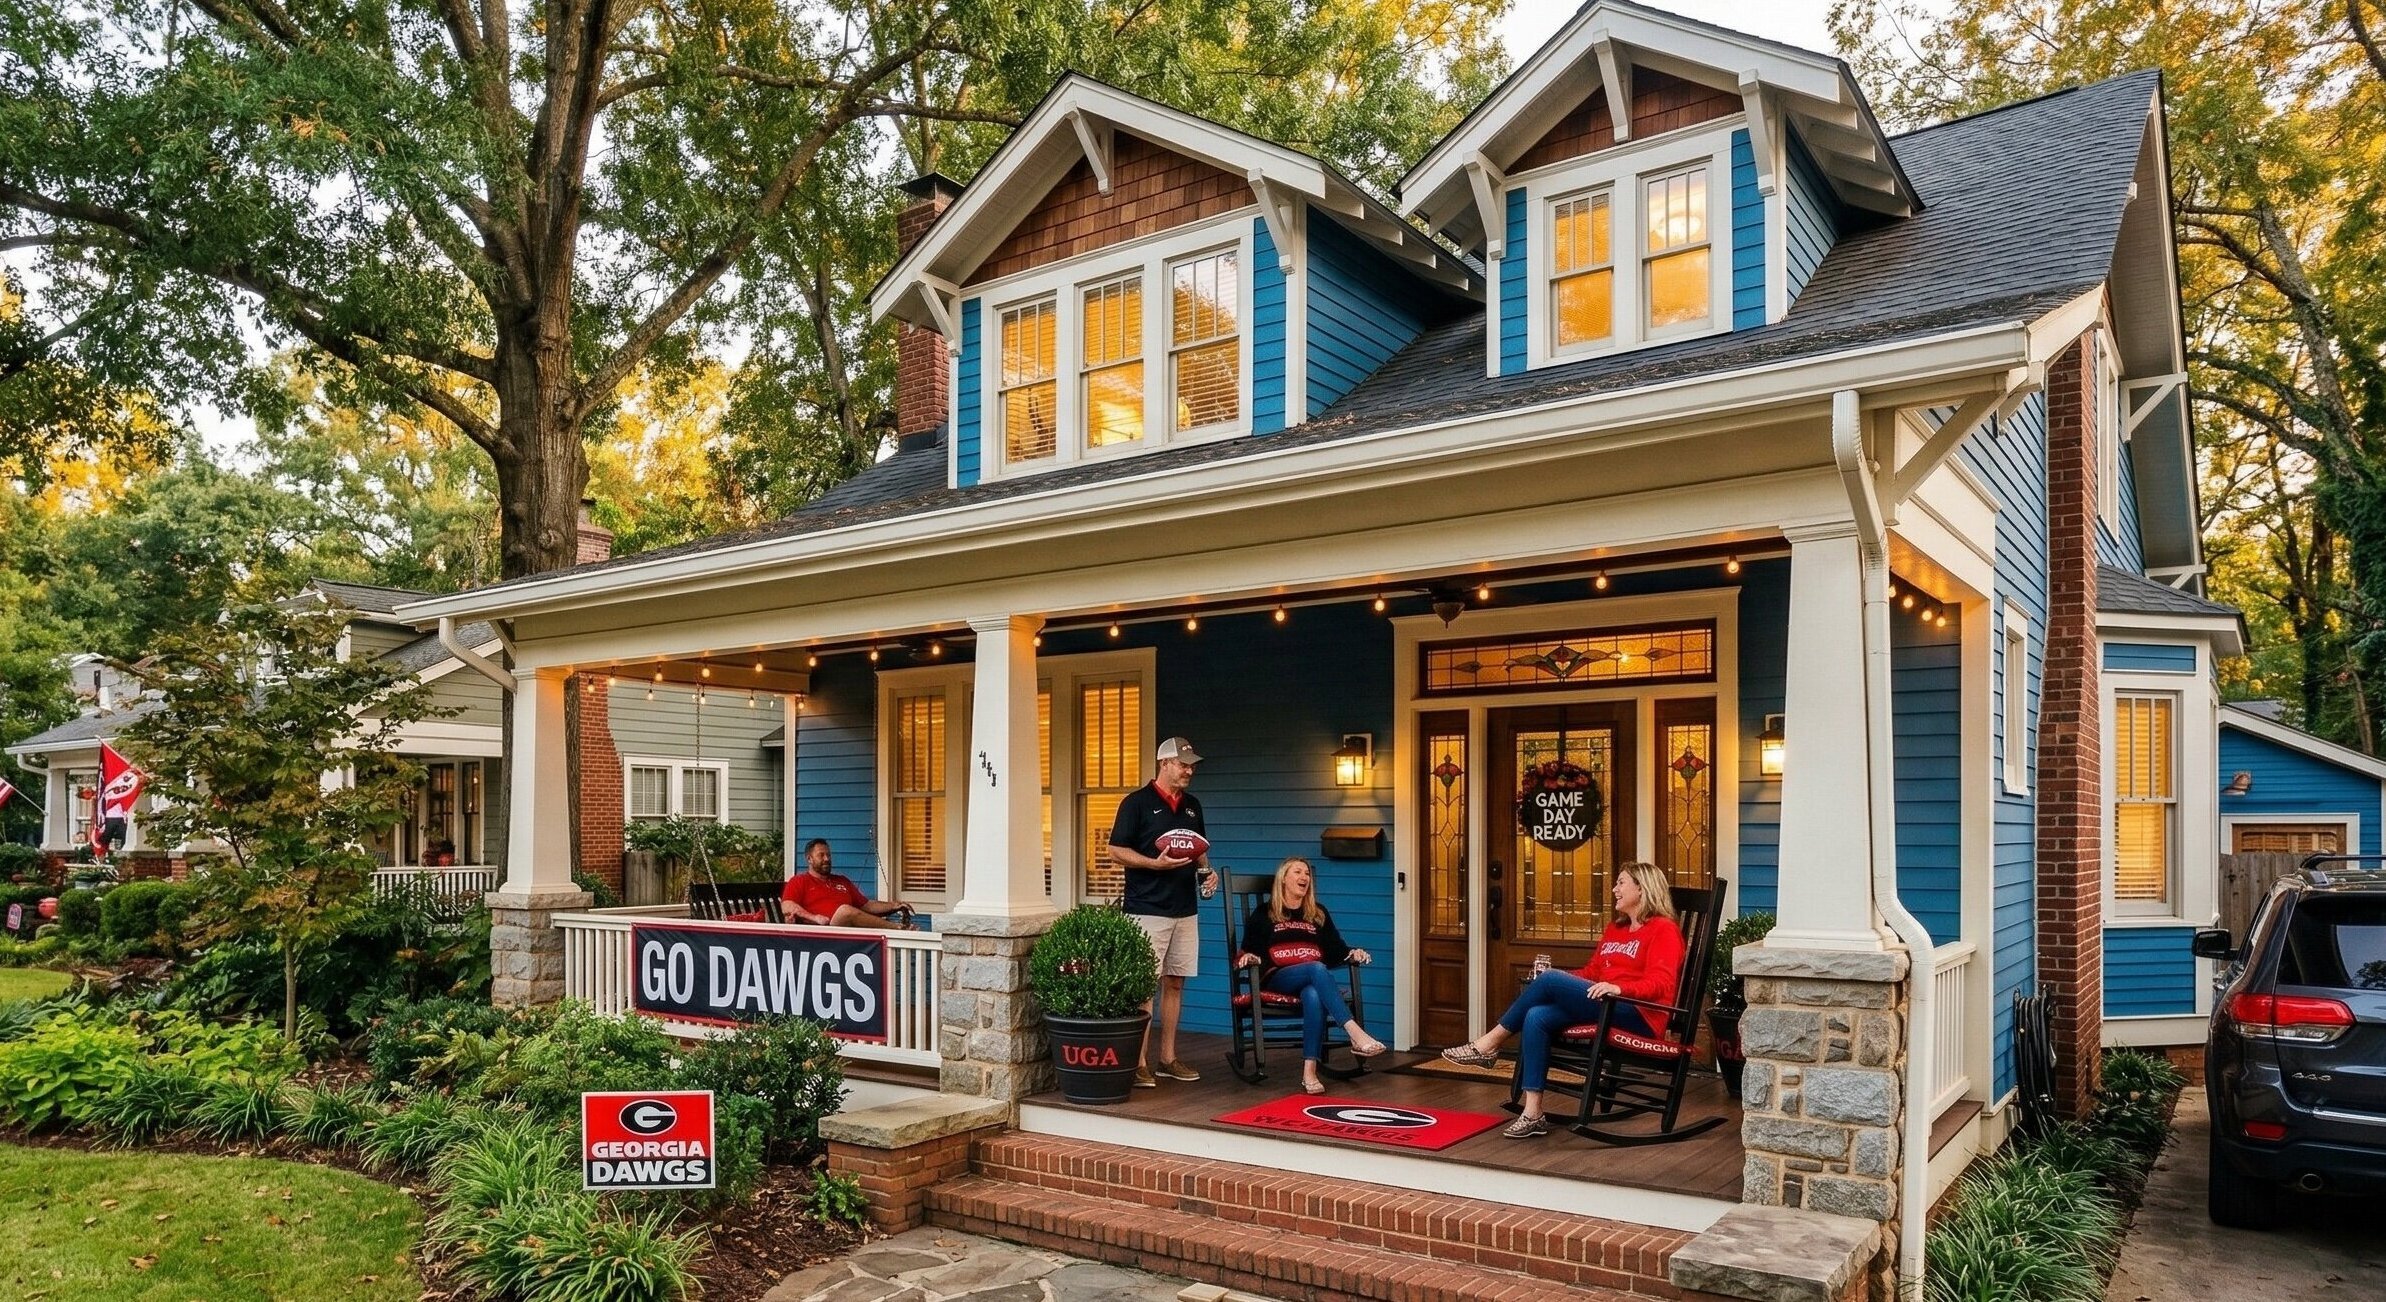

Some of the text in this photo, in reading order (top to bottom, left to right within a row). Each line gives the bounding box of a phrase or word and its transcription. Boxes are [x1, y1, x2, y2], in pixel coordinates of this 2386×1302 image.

[1535, 792, 1584, 807] GAME
[1543, 808, 1576, 824] DAY
[1533, 825, 1586, 840] READY
[642, 940, 876, 1022] GO DAWGS
[1062, 1045, 1118, 1066] UGA
[634, 1106, 675, 1128] G
[591, 1141, 706, 1158] GEORGIA
[592, 1160, 707, 1182] DAWGS
